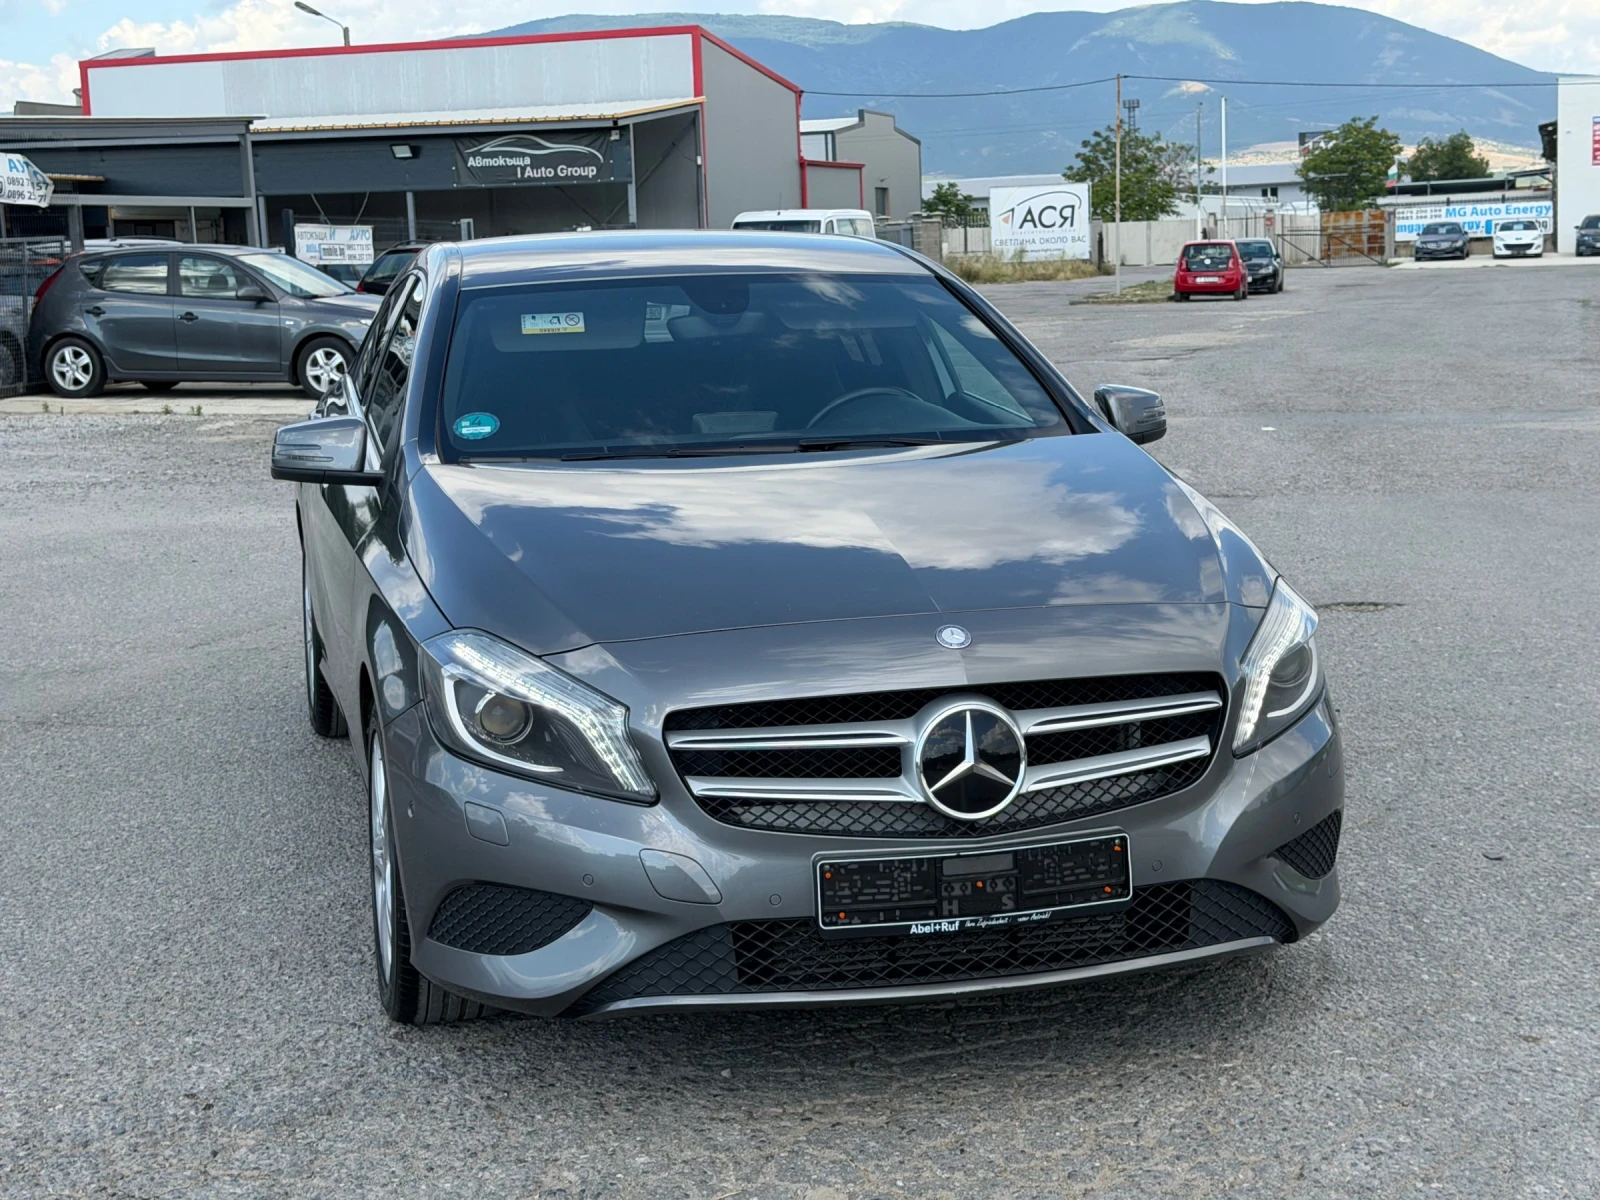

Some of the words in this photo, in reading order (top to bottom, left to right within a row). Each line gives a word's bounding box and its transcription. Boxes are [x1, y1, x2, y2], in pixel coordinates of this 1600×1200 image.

[524, 167, 554, 178] Auto
[557, 165, 597, 178] Group
[8, 190, 26, 200] 0896
[1018, 204, 1076, 230] АСЯ
[1445, 207, 1467, 219] MG
[1470, 206, 1502, 217] Auto
[1505, 204, 1552, 217] Energy
[994, 237, 1037, 247] СВЕТЛИНА
[1039, 235, 1068, 245] ОКОЛО
[1071, 235, 1087, 243] ВАС
[472, 416, 481, 426] 4
[910, 921, 960, 934] Abel+Ruf
